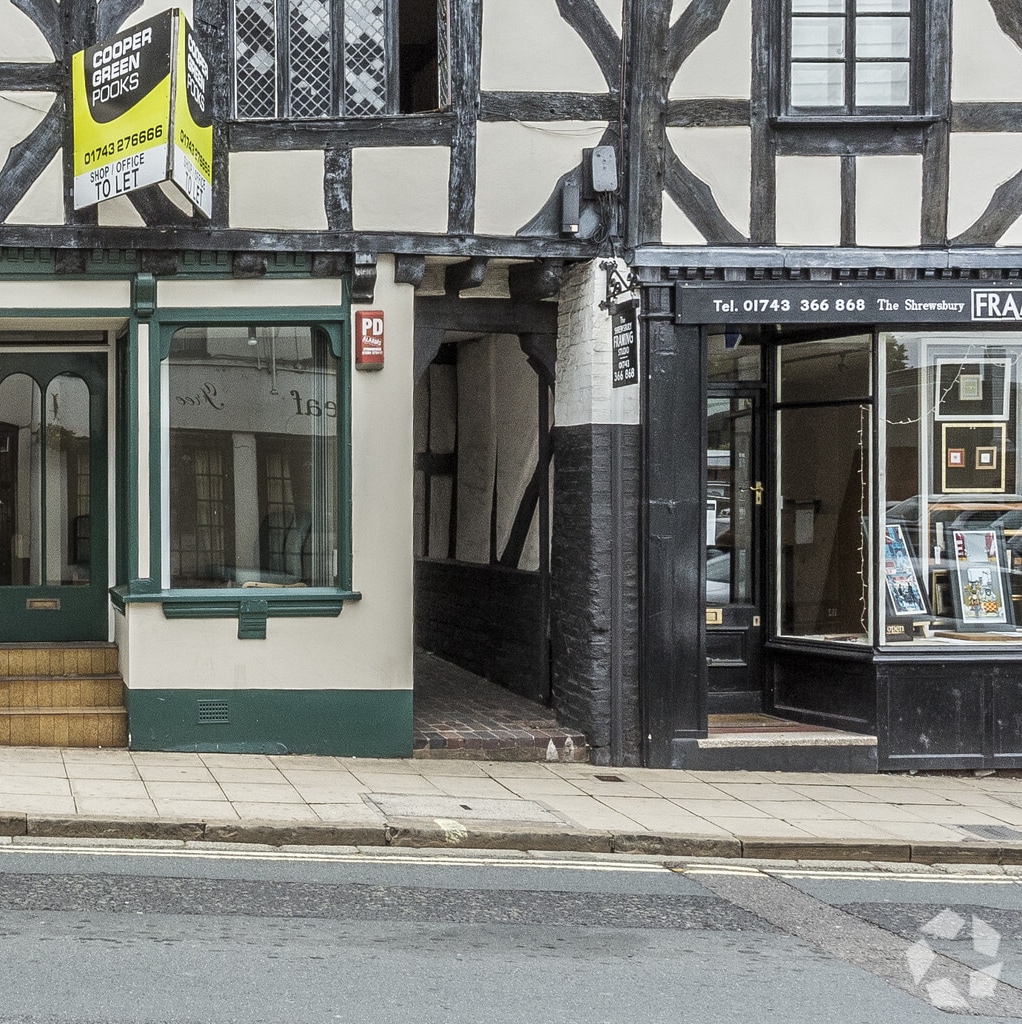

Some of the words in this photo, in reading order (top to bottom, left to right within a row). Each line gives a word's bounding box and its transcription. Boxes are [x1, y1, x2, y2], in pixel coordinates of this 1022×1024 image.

[92, 27, 152, 69] COOPER
[187, 32, 209, 81] COOPER
[92, 51, 141, 88] GREEN
[187, 53, 206, 94] GREEN
[92, 72, 140, 107] POOKS
[187, 72, 205, 113] POOKS
[84, 142, 115, 165] 01743
[117, 124, 163, 153] 276666
[90, 166, 110, 183] SHOP
[116, 152, 145, 173] OFFICE
[95, 178, 111, 201] TO
[115, 167, 140, 194] LET
[185, 171, 192, 195] TO
[193, 180, 204, 207] LET
[713, 300, 739, 312] Tel.
[744, 299, 791, 312] 01743
[800, 299, 830, 312] 366
[835, 299, 866, 312] 868
[877, 299, 899, 311] The
[905, 299, 966, 313] Shrewsbury
[973, 293, 1022, 320] FRA
[361, 318, 384, 336] PD
[613, 331, 634, 349] FRAMING
[617, 346, 630, 357] STUDIO
[618, 359, 630, 369] 01743
[614, 370, 624, 382] 366
[624, 367, 635, 380] 868
